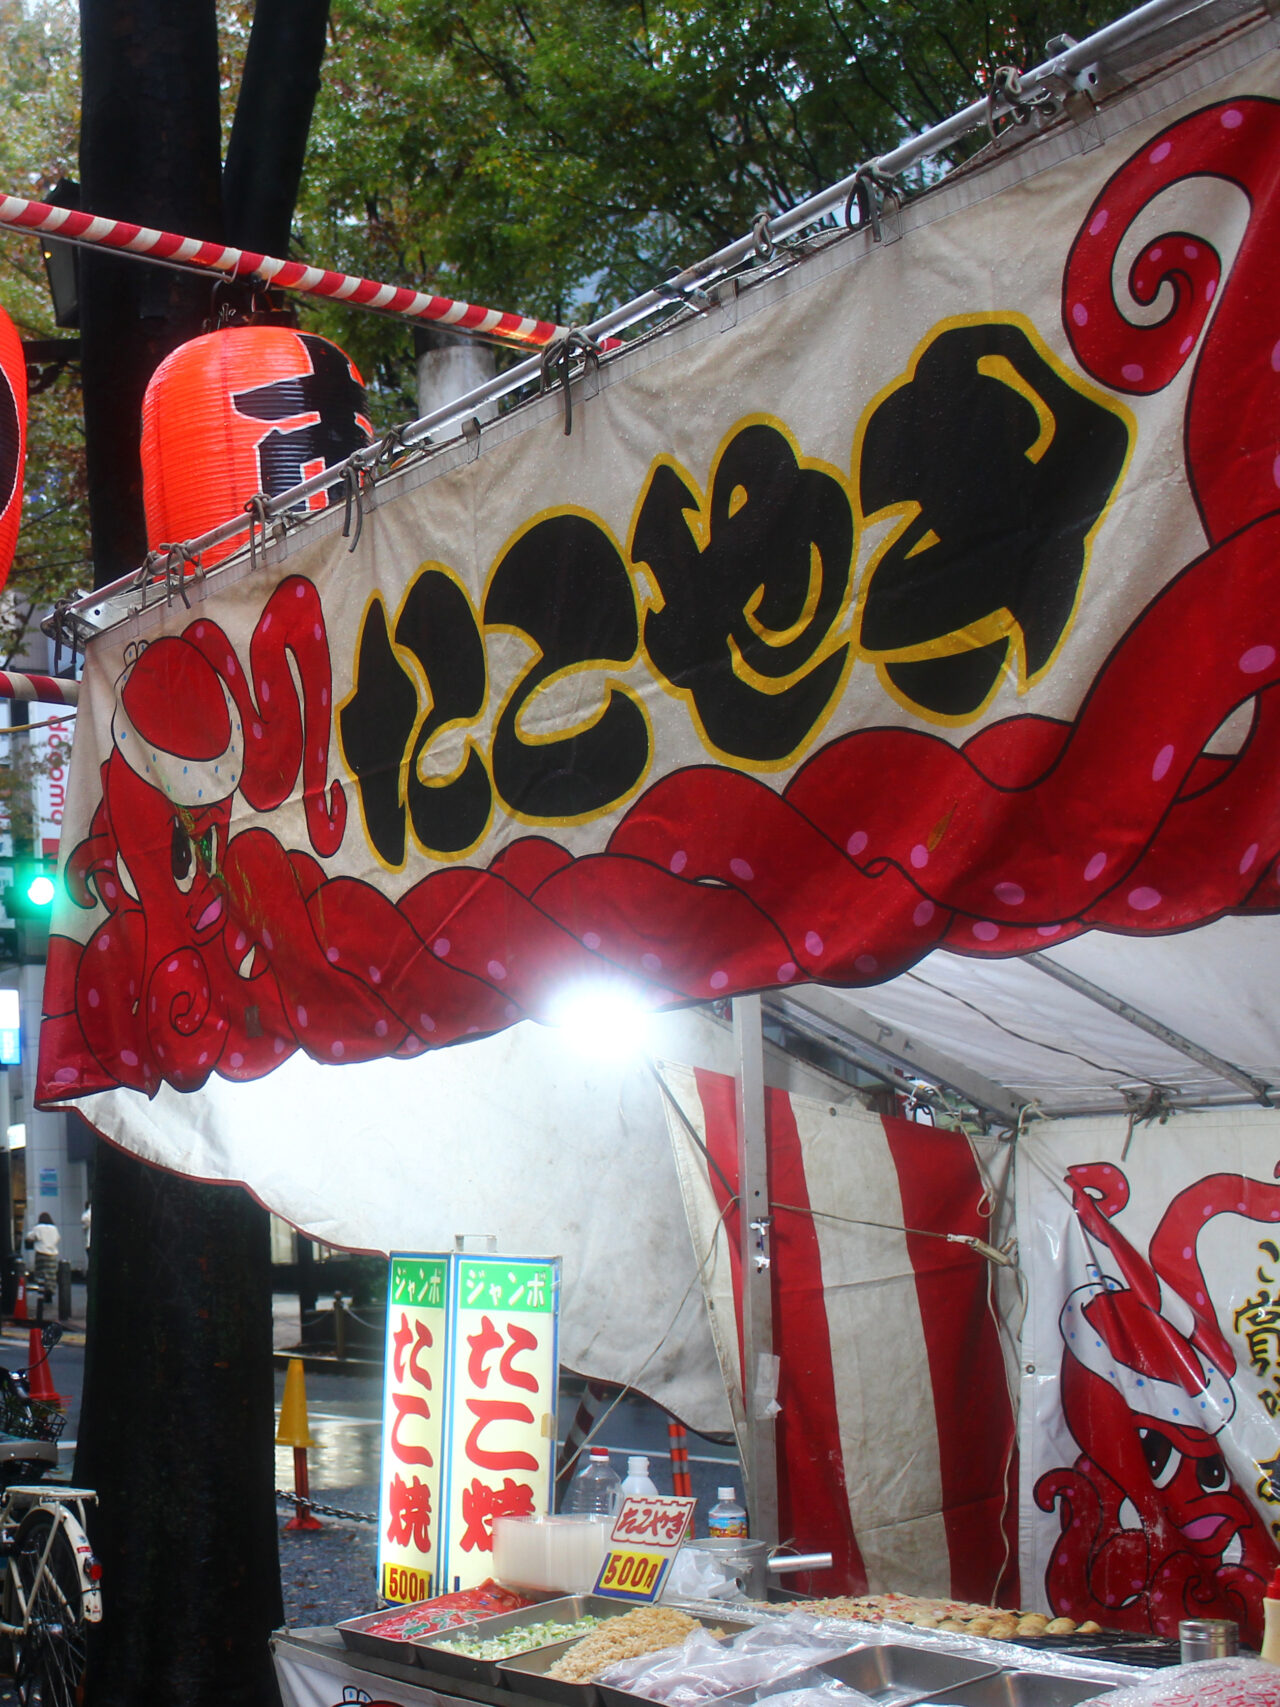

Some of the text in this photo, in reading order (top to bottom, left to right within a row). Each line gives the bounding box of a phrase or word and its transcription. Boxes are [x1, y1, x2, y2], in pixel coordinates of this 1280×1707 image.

[334, 310, 1138, 873] たこやき
[394, 1267, 443, 1306] ジャンボ
[465, 1271, 548, 1309] ジャンボ
[386, 1312, 435, 1554] たこ焼
